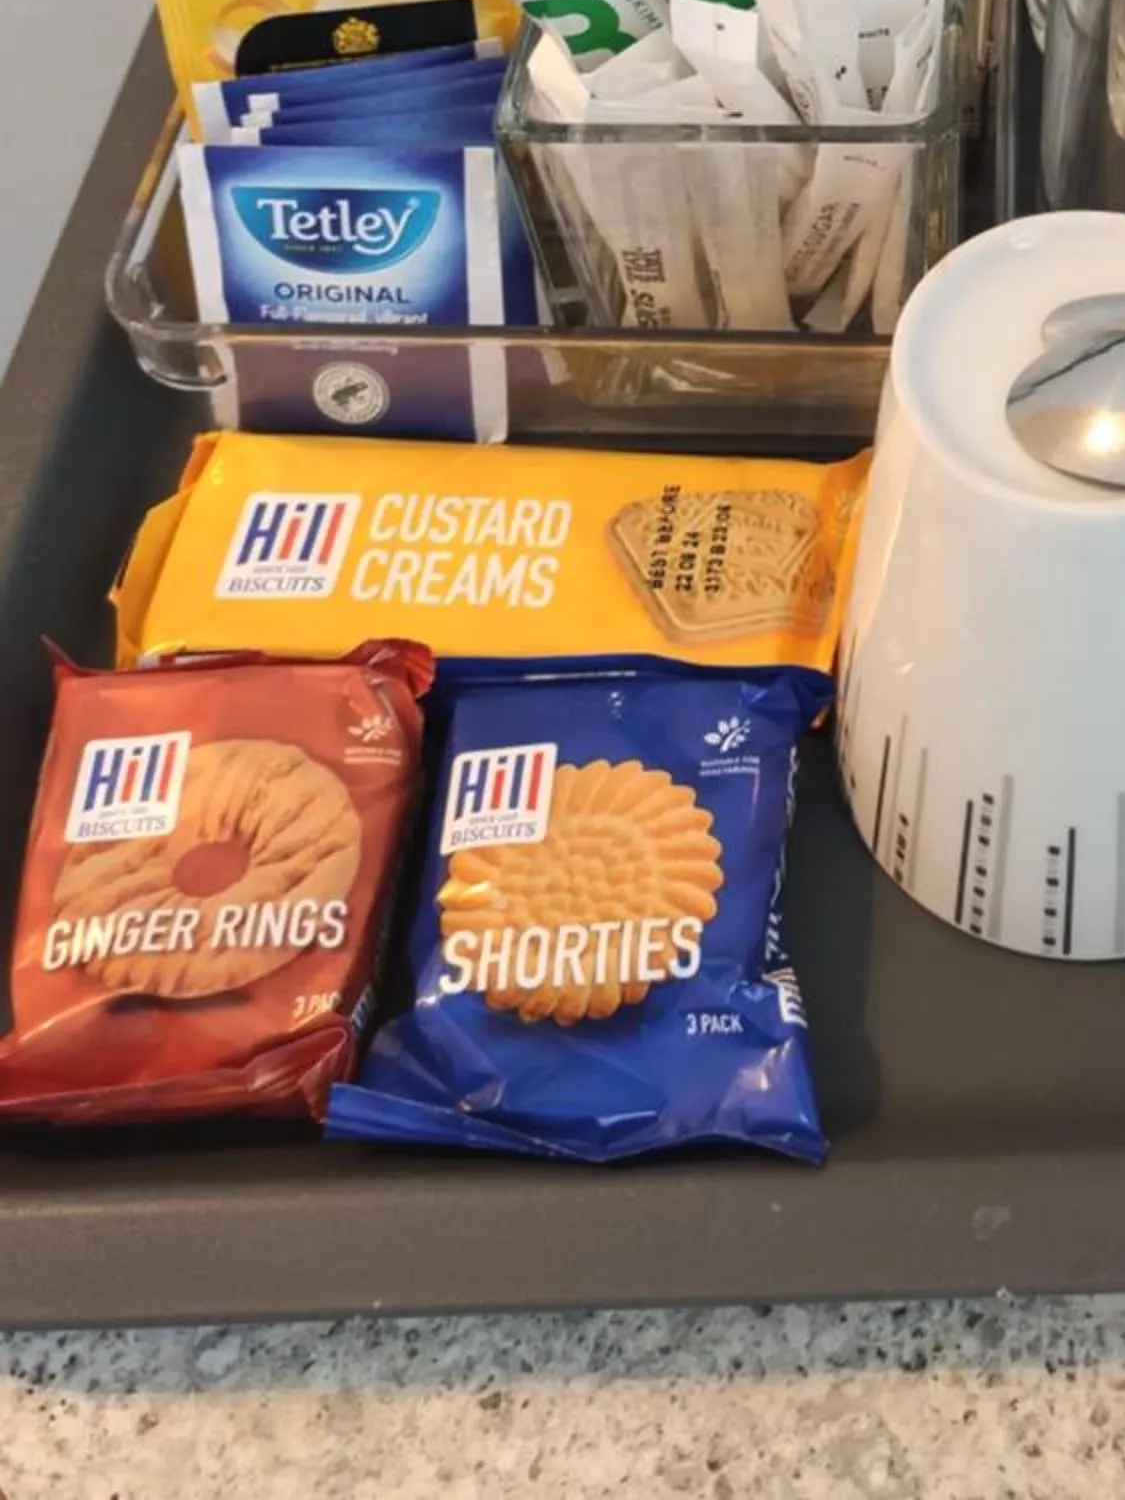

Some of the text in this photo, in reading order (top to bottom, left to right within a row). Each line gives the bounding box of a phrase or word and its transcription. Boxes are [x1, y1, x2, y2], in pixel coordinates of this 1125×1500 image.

[257, 198, 414, 255] Tetley
[274, 282, 411, 303] ORIGINAL
[236, 502, 346, 565] Hill
[369, 493, 572, 548] CUSTARD
[228, 576, 327, 592] BISCUITS
[352, 548, 559, 608] CREAMS
[83, 740, 178, 812] Hill
[453, 752, 545, 822] Hill
[77, 815, 167, 838] BISCUITS
[449, 821, 537, 846] BISCUITS
[42, 899, 348, 971] GINGER RINGS
[439, 916, 703, 994] SHORTIES
[292, 995, 305, 1018] 3
[307, 991, 341, 1013] PAC
[686, 1013, 743, 1034] 3 PACK
